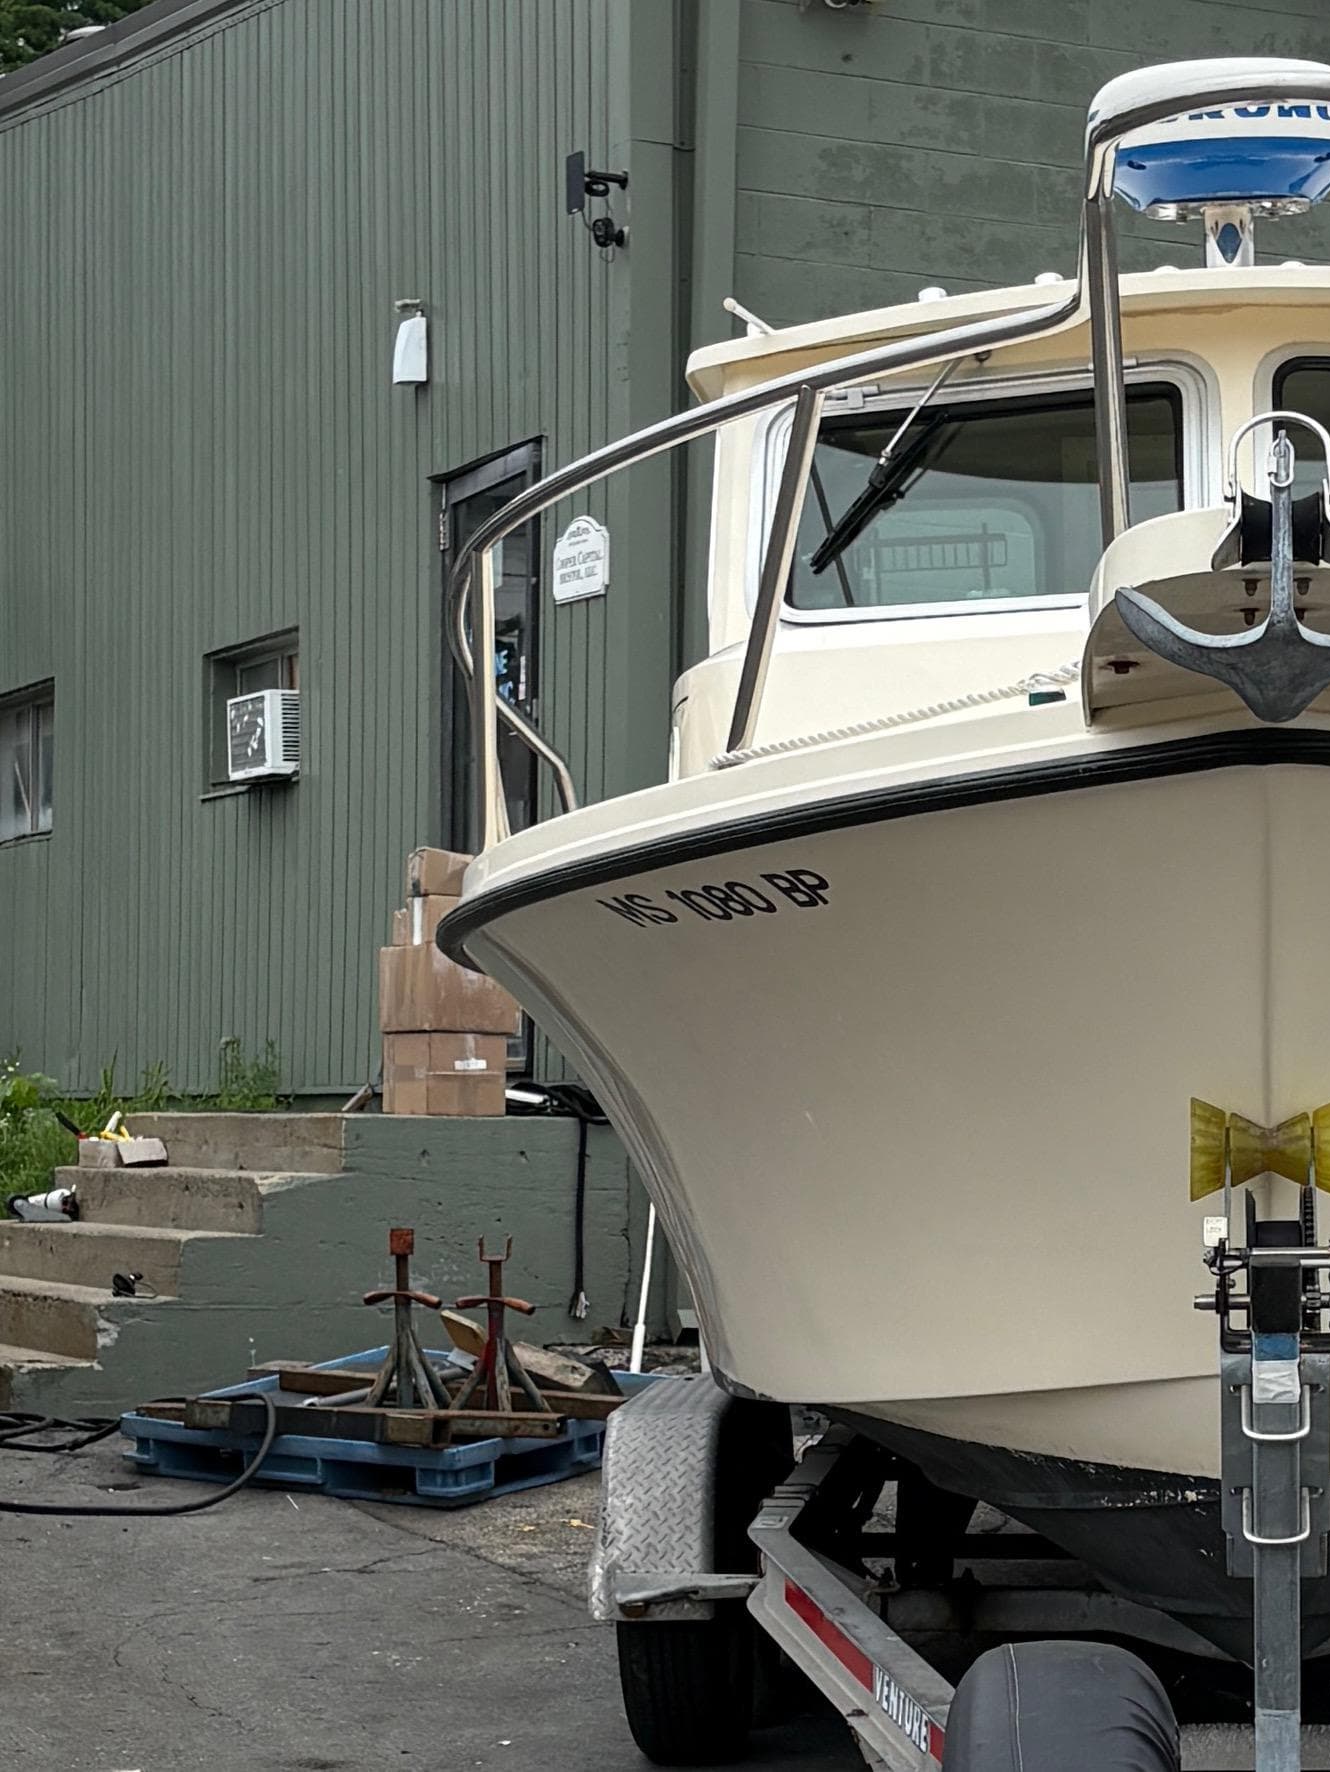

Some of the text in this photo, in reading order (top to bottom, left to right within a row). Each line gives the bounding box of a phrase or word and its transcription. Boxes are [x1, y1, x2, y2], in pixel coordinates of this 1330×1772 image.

[595, 869, 830, 928] MS 1080 BP
[874, 1666, 930, 1753] VENTURE
